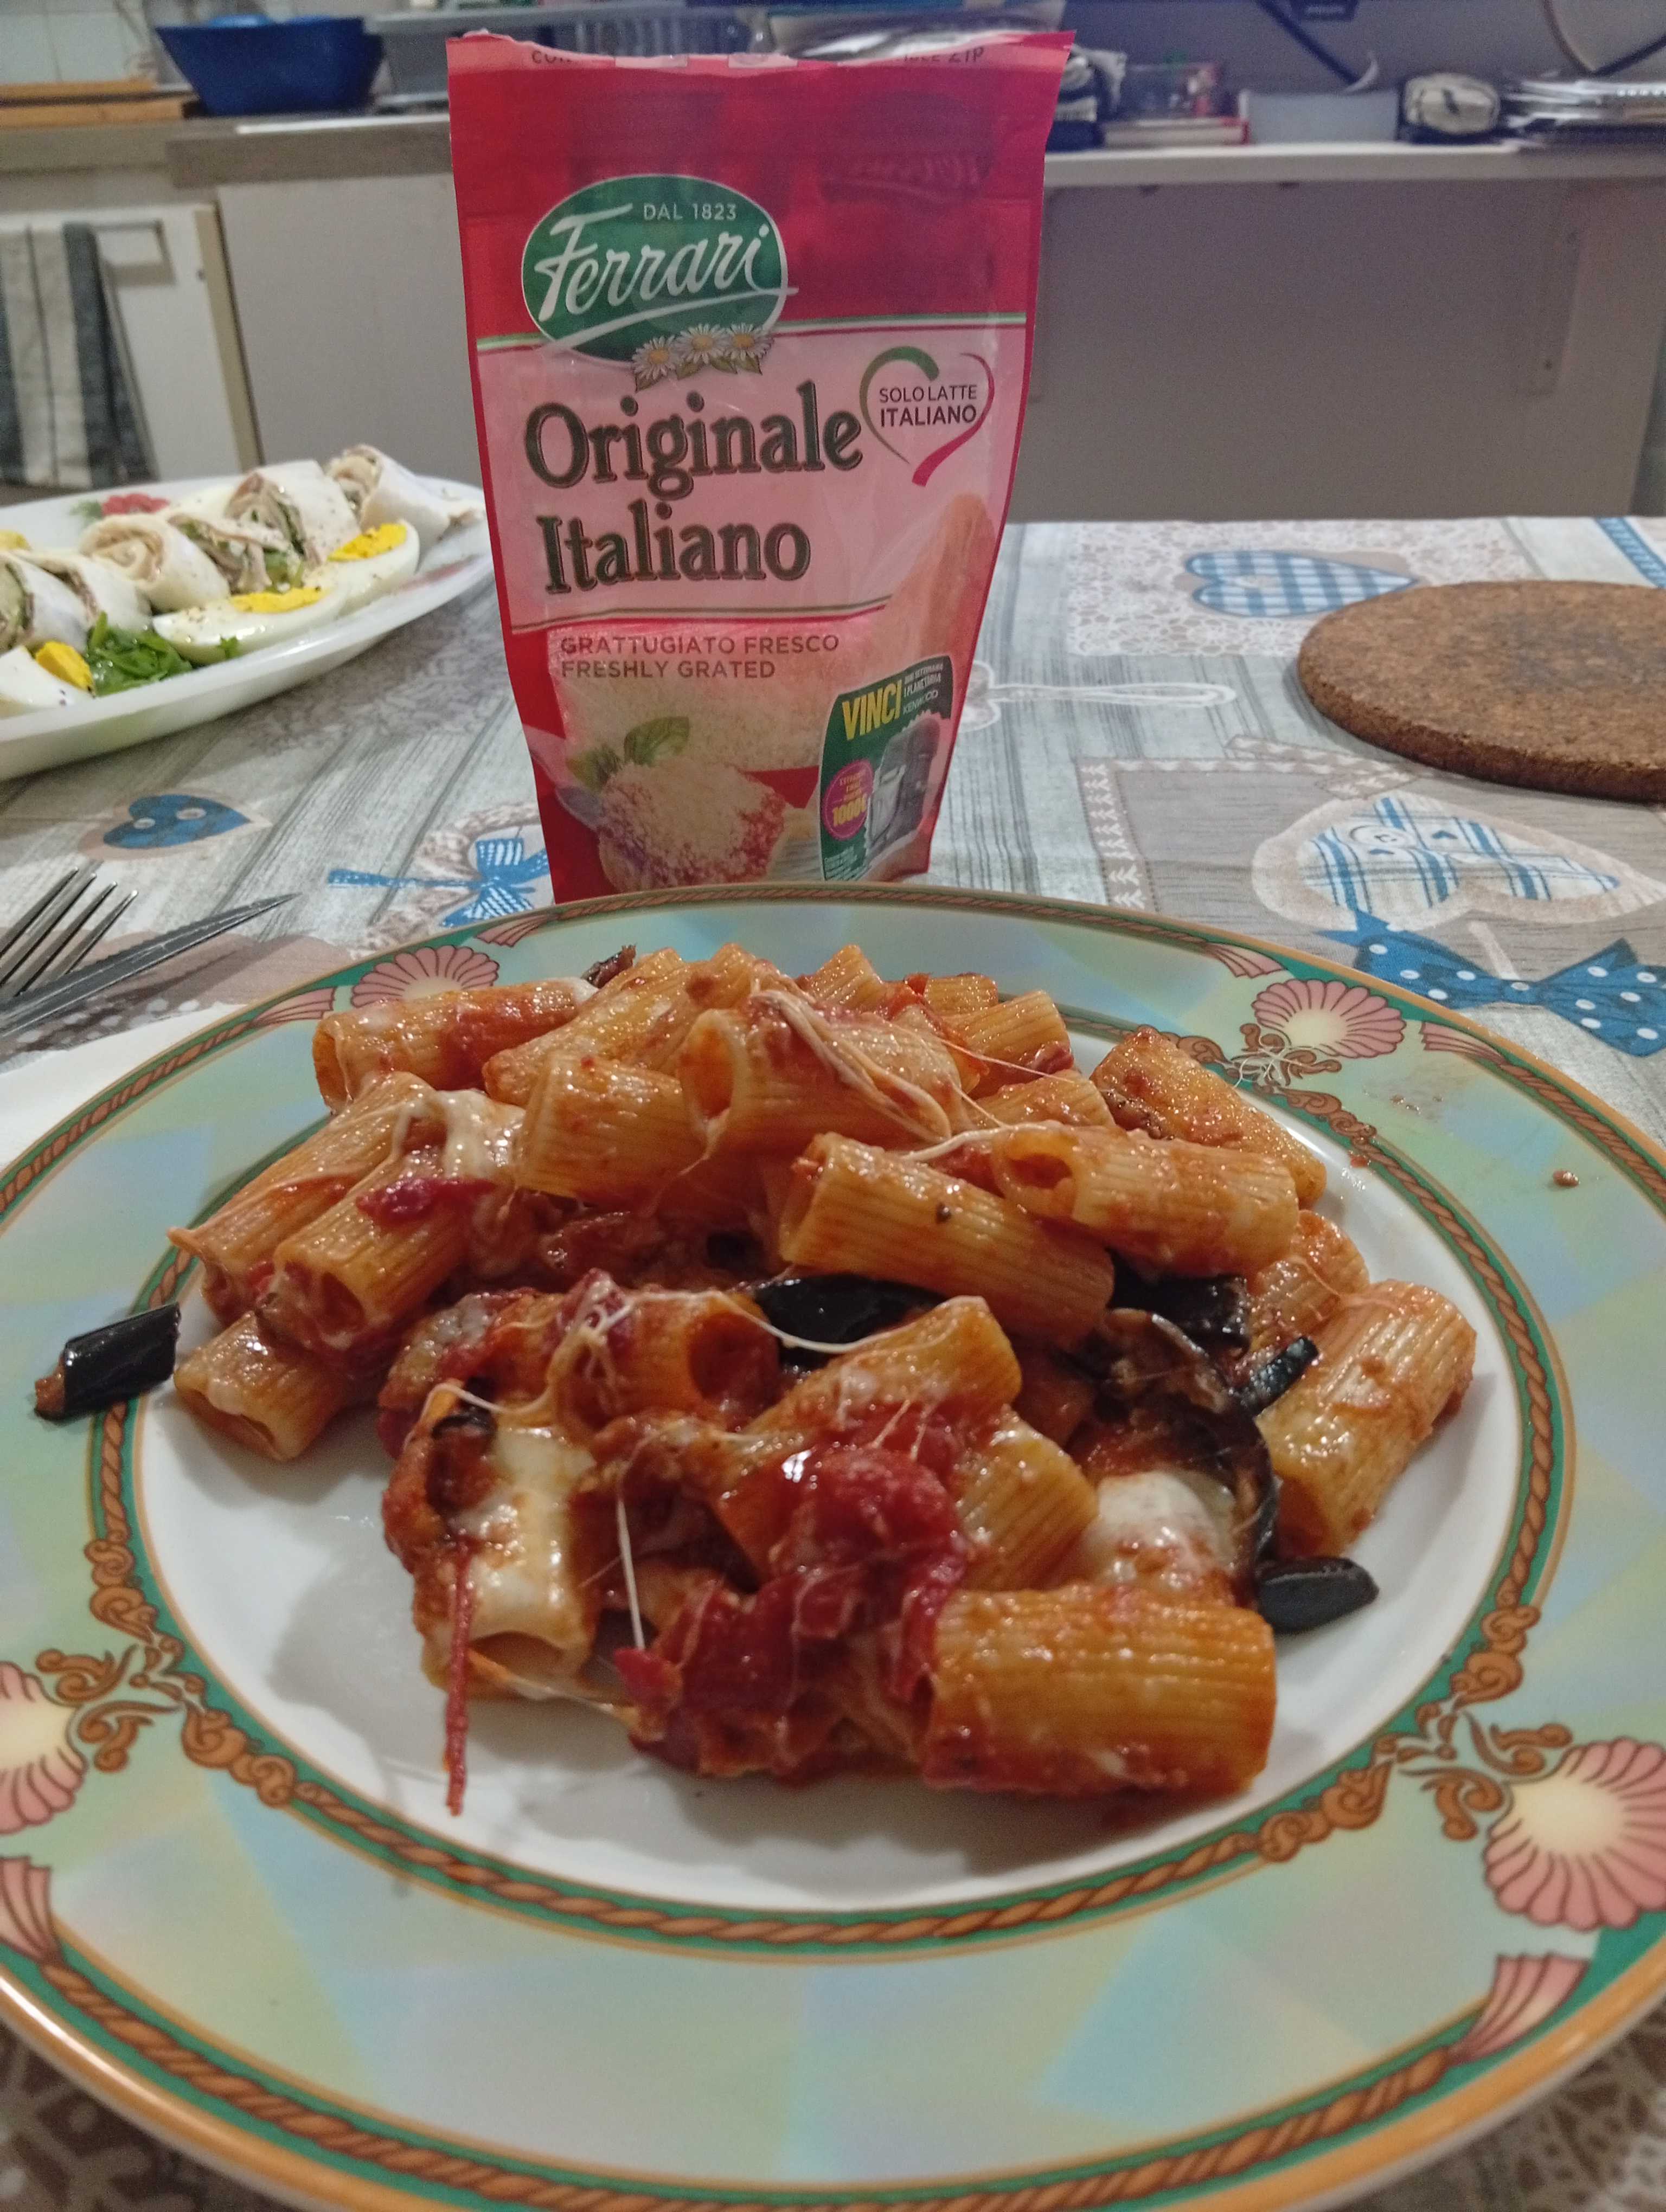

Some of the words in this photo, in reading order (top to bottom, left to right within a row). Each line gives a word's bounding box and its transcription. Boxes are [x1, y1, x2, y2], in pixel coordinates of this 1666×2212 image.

[644, 203, 683, 221] DAL
[693, 203, 738, 221] 1823
[535, 203, 776, 322] Ferrari
[879, 386, 925, 403] SOLO
[928, 384, 977, 401] LATTE
[880, 404, 977, 427] ITALIANO
[525, 378, 863, 500] Originale
[536, 499, 811, 595] Italiano
[560, 635, 735, 655] GRATTUGIATO
[745, 634, 840, 654] FRESCO
[561, 660, 669, 679] FRESHLY
[677, 660, 776, 679] GRATED
[841, 679, 903, 741] VINCI
